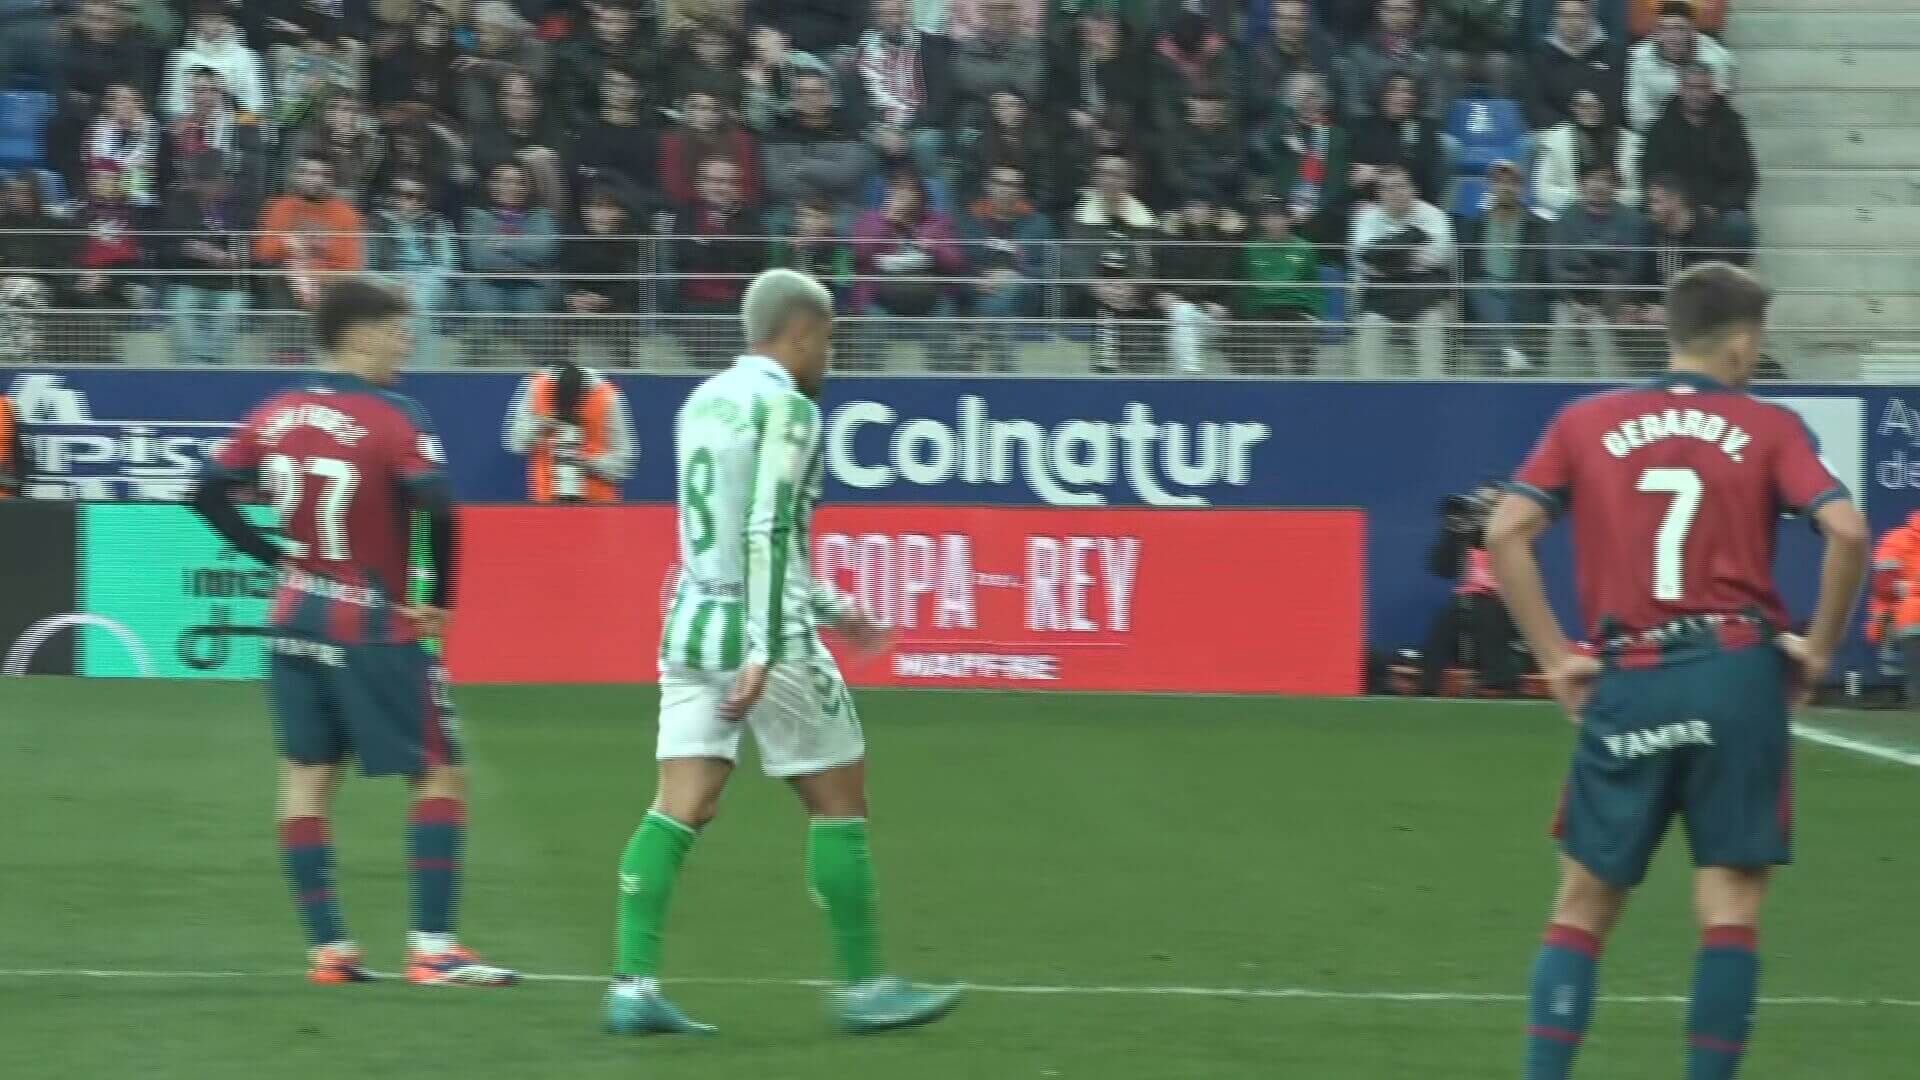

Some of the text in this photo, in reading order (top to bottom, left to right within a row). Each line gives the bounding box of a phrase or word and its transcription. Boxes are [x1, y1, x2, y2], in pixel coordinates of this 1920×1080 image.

[823, 394, 1273, 506] Colnatur
[1602, 408, 1729, 458] GERARD
[257, 454, 363, 561] 27
[684, 446, 716, 555] 8
[1635, 467, 1705, 602] 7
[815, 532, 979, 630] COPA
[1023, 535, 1142, 633] REY
[890, 652, 1061, 681] MAPFRE
